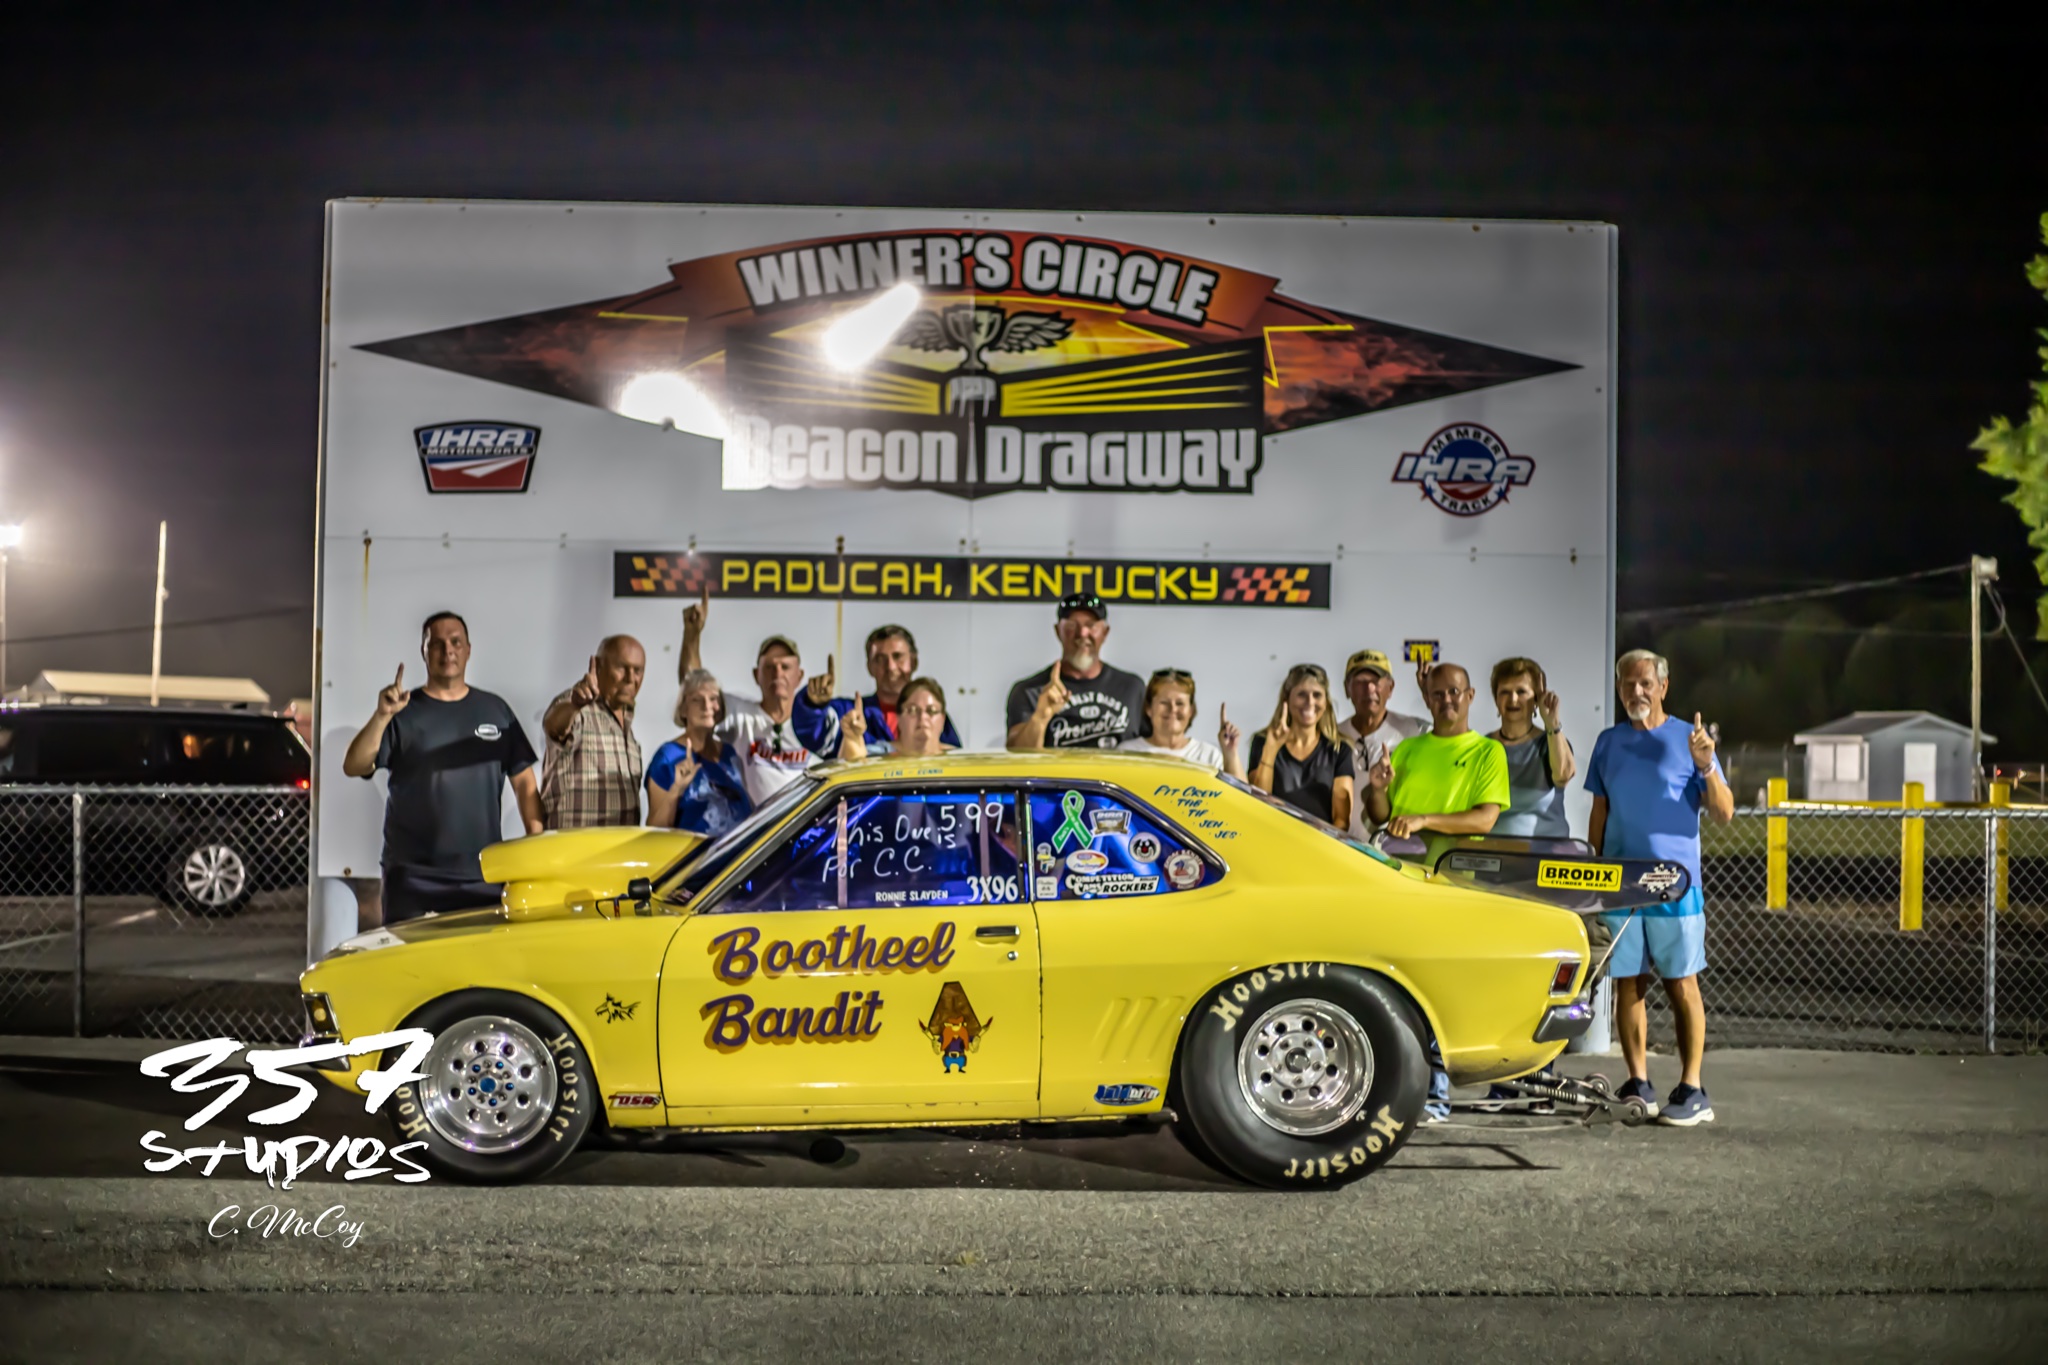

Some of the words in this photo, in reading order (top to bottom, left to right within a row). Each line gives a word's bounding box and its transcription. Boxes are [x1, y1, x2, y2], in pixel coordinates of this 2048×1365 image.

[738, 237, 1011, 306] WINNER'S
[1021, 239, 1217, 322] CIRCLE
[427, 446, 529, 456] MOTORSPORTS
[428, 428, 527, 447] IHRA
[1431, 427, 1502, 455] MEMBER
[1396, 456, 1533, 484] IHRA
[1439, 494, 1493, 513] TRACK
[723, 560, 952, 597] PADUCAH,
[969, 562, 1218, 600] KENTUCKY
[828, 803, 884, 849] This
[937, 826, 957, 849] is
[940, 801, 1004, 834] 5.99
[967, 875, 1019, 903] 3X96
[1103, 882, 1154, 893] ROCKERS
[1545, 867, 1615, 883] BRODIX
[1550, 879, 1583, 887] CYLINDER
[875, 891, 906, 902] RONNIE
[909, 890, 948, 901] SLAYDEN
[710, 921, 956, 983] Bootheel
[702, 990, 885, 1050] Bandit
